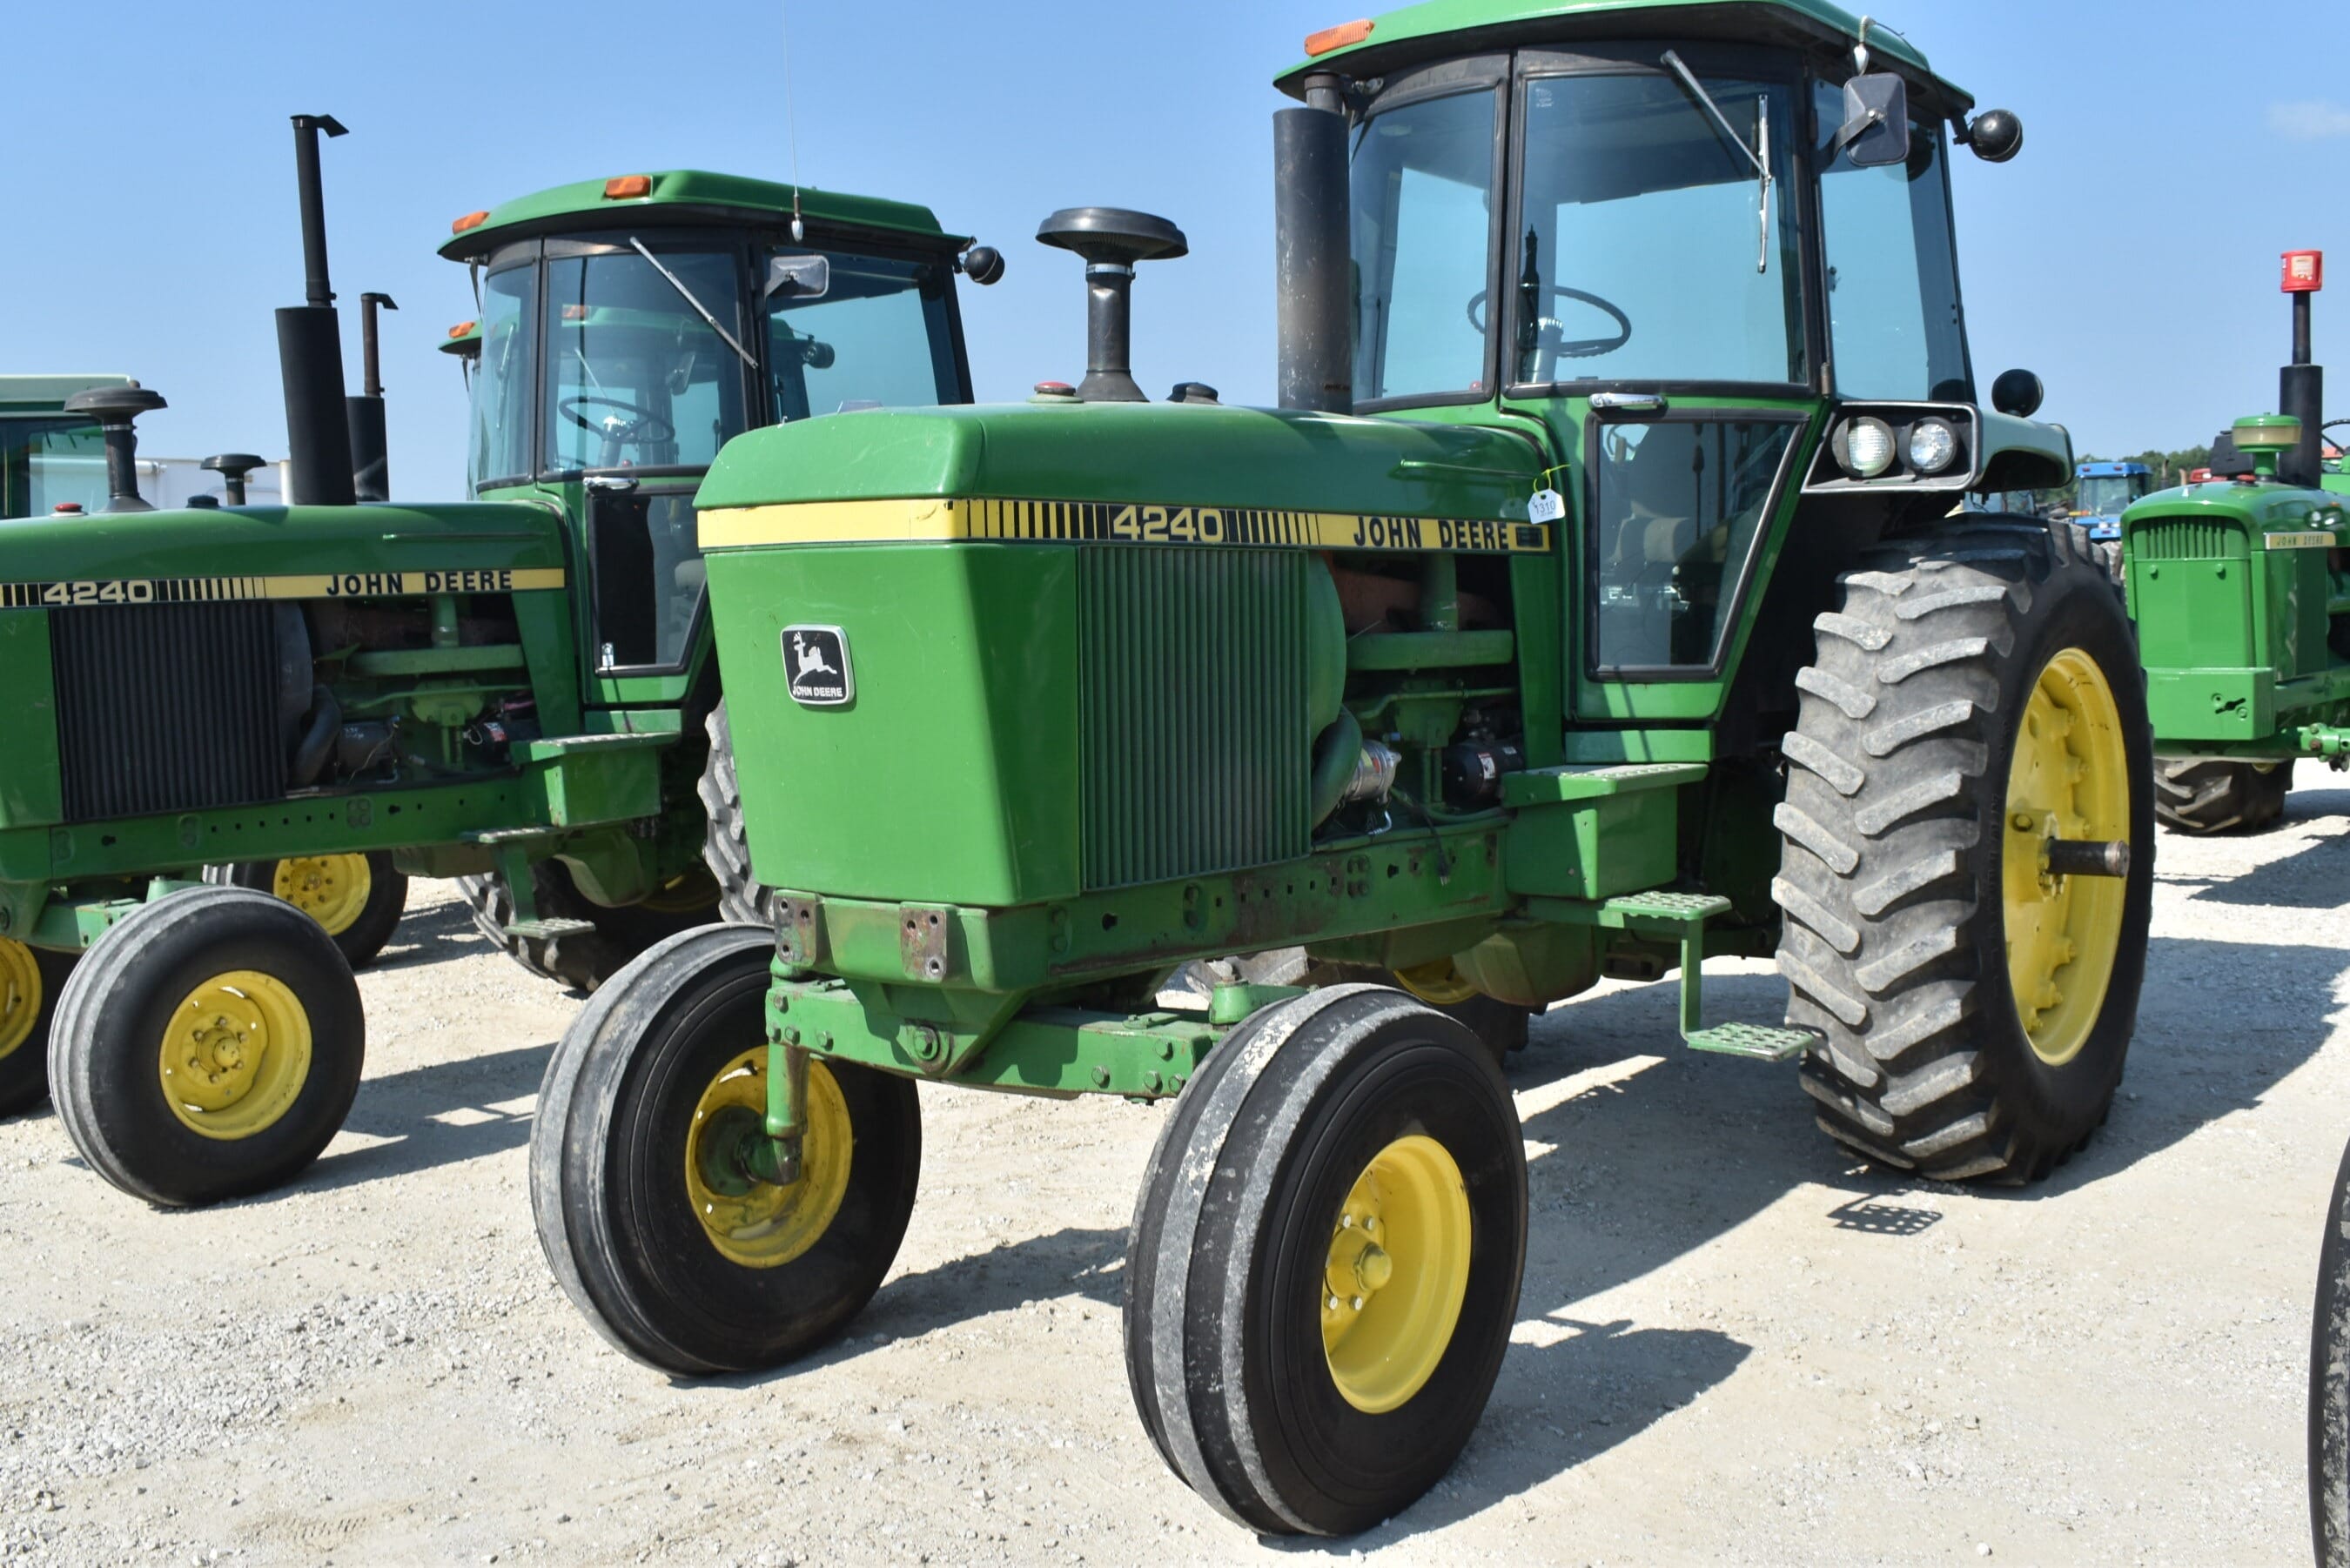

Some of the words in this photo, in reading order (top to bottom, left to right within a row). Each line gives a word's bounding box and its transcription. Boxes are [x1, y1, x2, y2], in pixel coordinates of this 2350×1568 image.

[1113, 505, 1224, 544] 4240
[1353, 515, 1422, 548] JOHN
[1438, 519, 1509, 551] DEERE
[44, 580, 154, 606] 4240
[326, 573, 404, 596] JOHN
[425, 570, 512, 593] DEERE
[793, 686, 813, 697] JOHN
[813, 687, 843, 697] DEERE
